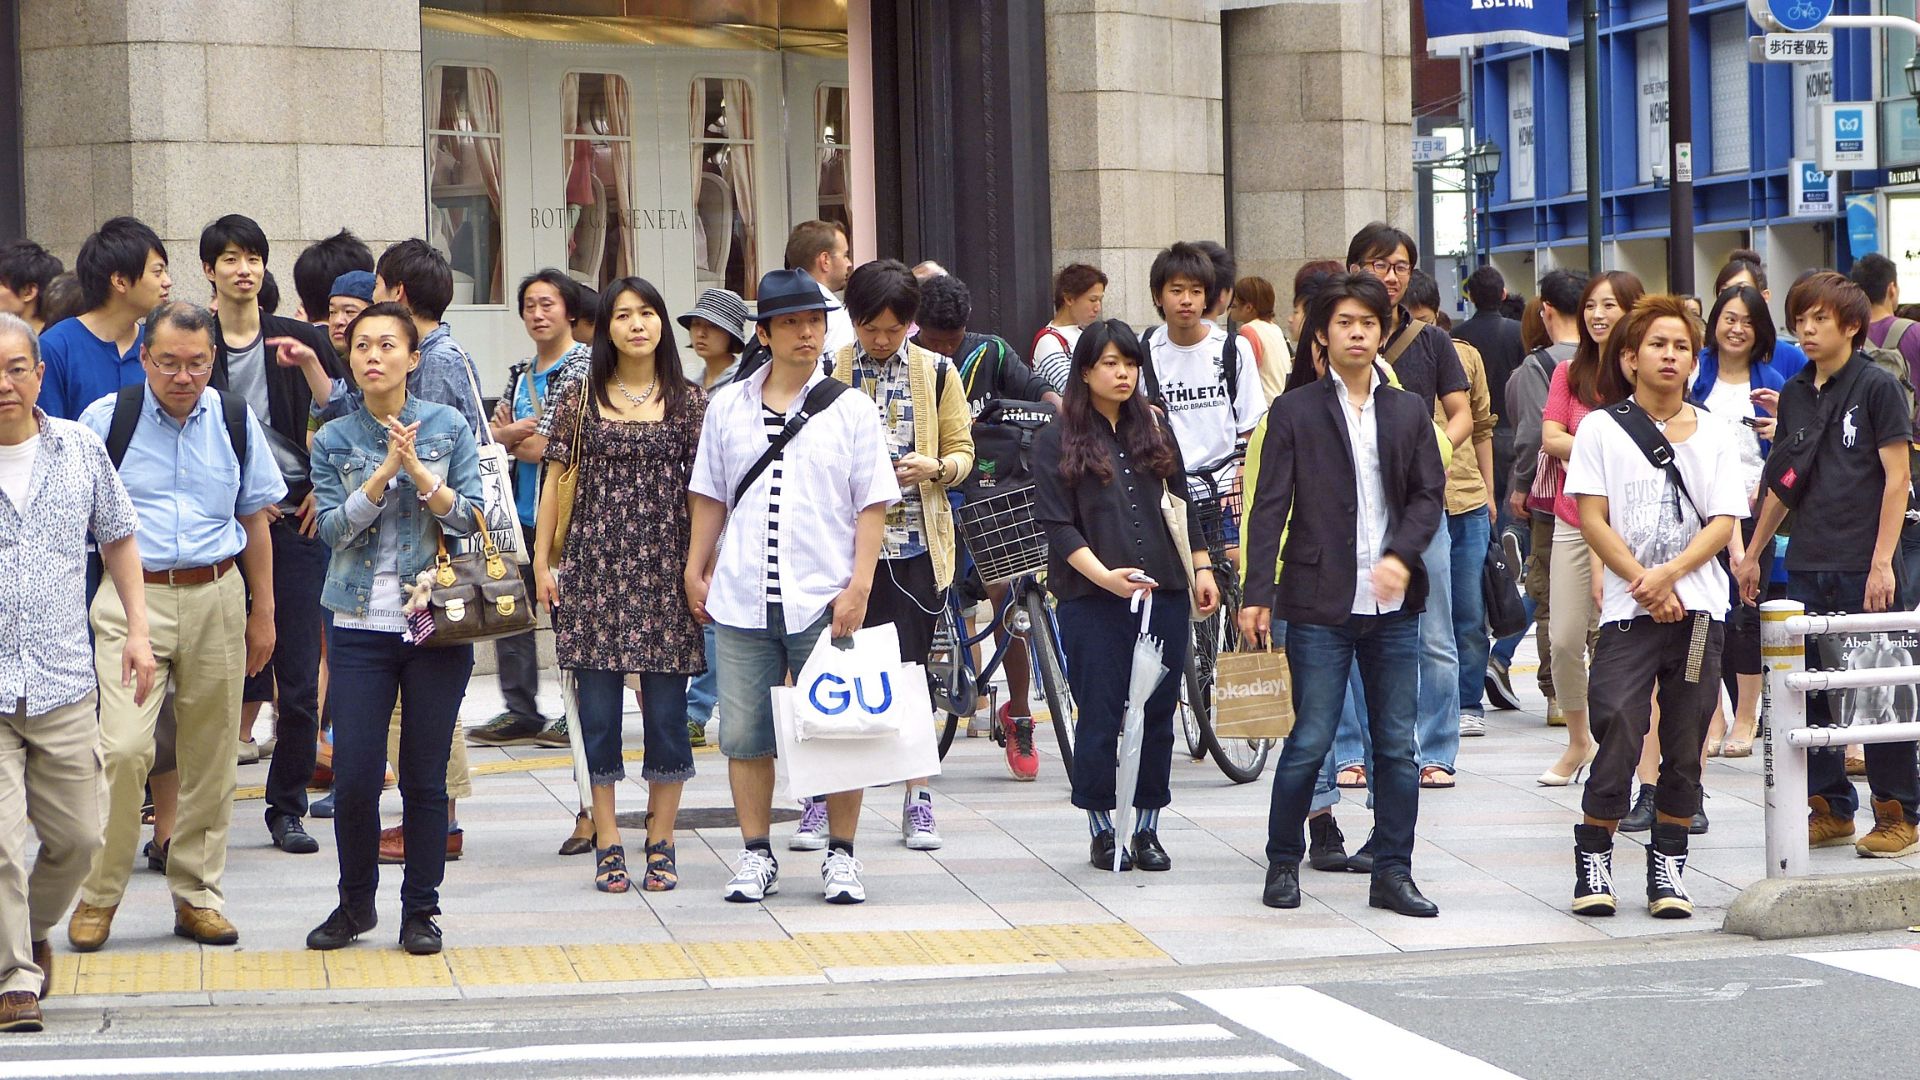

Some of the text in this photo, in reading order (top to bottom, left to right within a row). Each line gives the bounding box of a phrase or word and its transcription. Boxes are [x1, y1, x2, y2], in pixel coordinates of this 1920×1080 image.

[1770, 40, 1828, 55] 歩行者優先
[1002, 412, 1051, 423] ATHLETA
[1624, 479, 1659, 505] ELVIS
[1843, 636, 1918, 648] Abembie
[808, 671, 893, 716] GU
